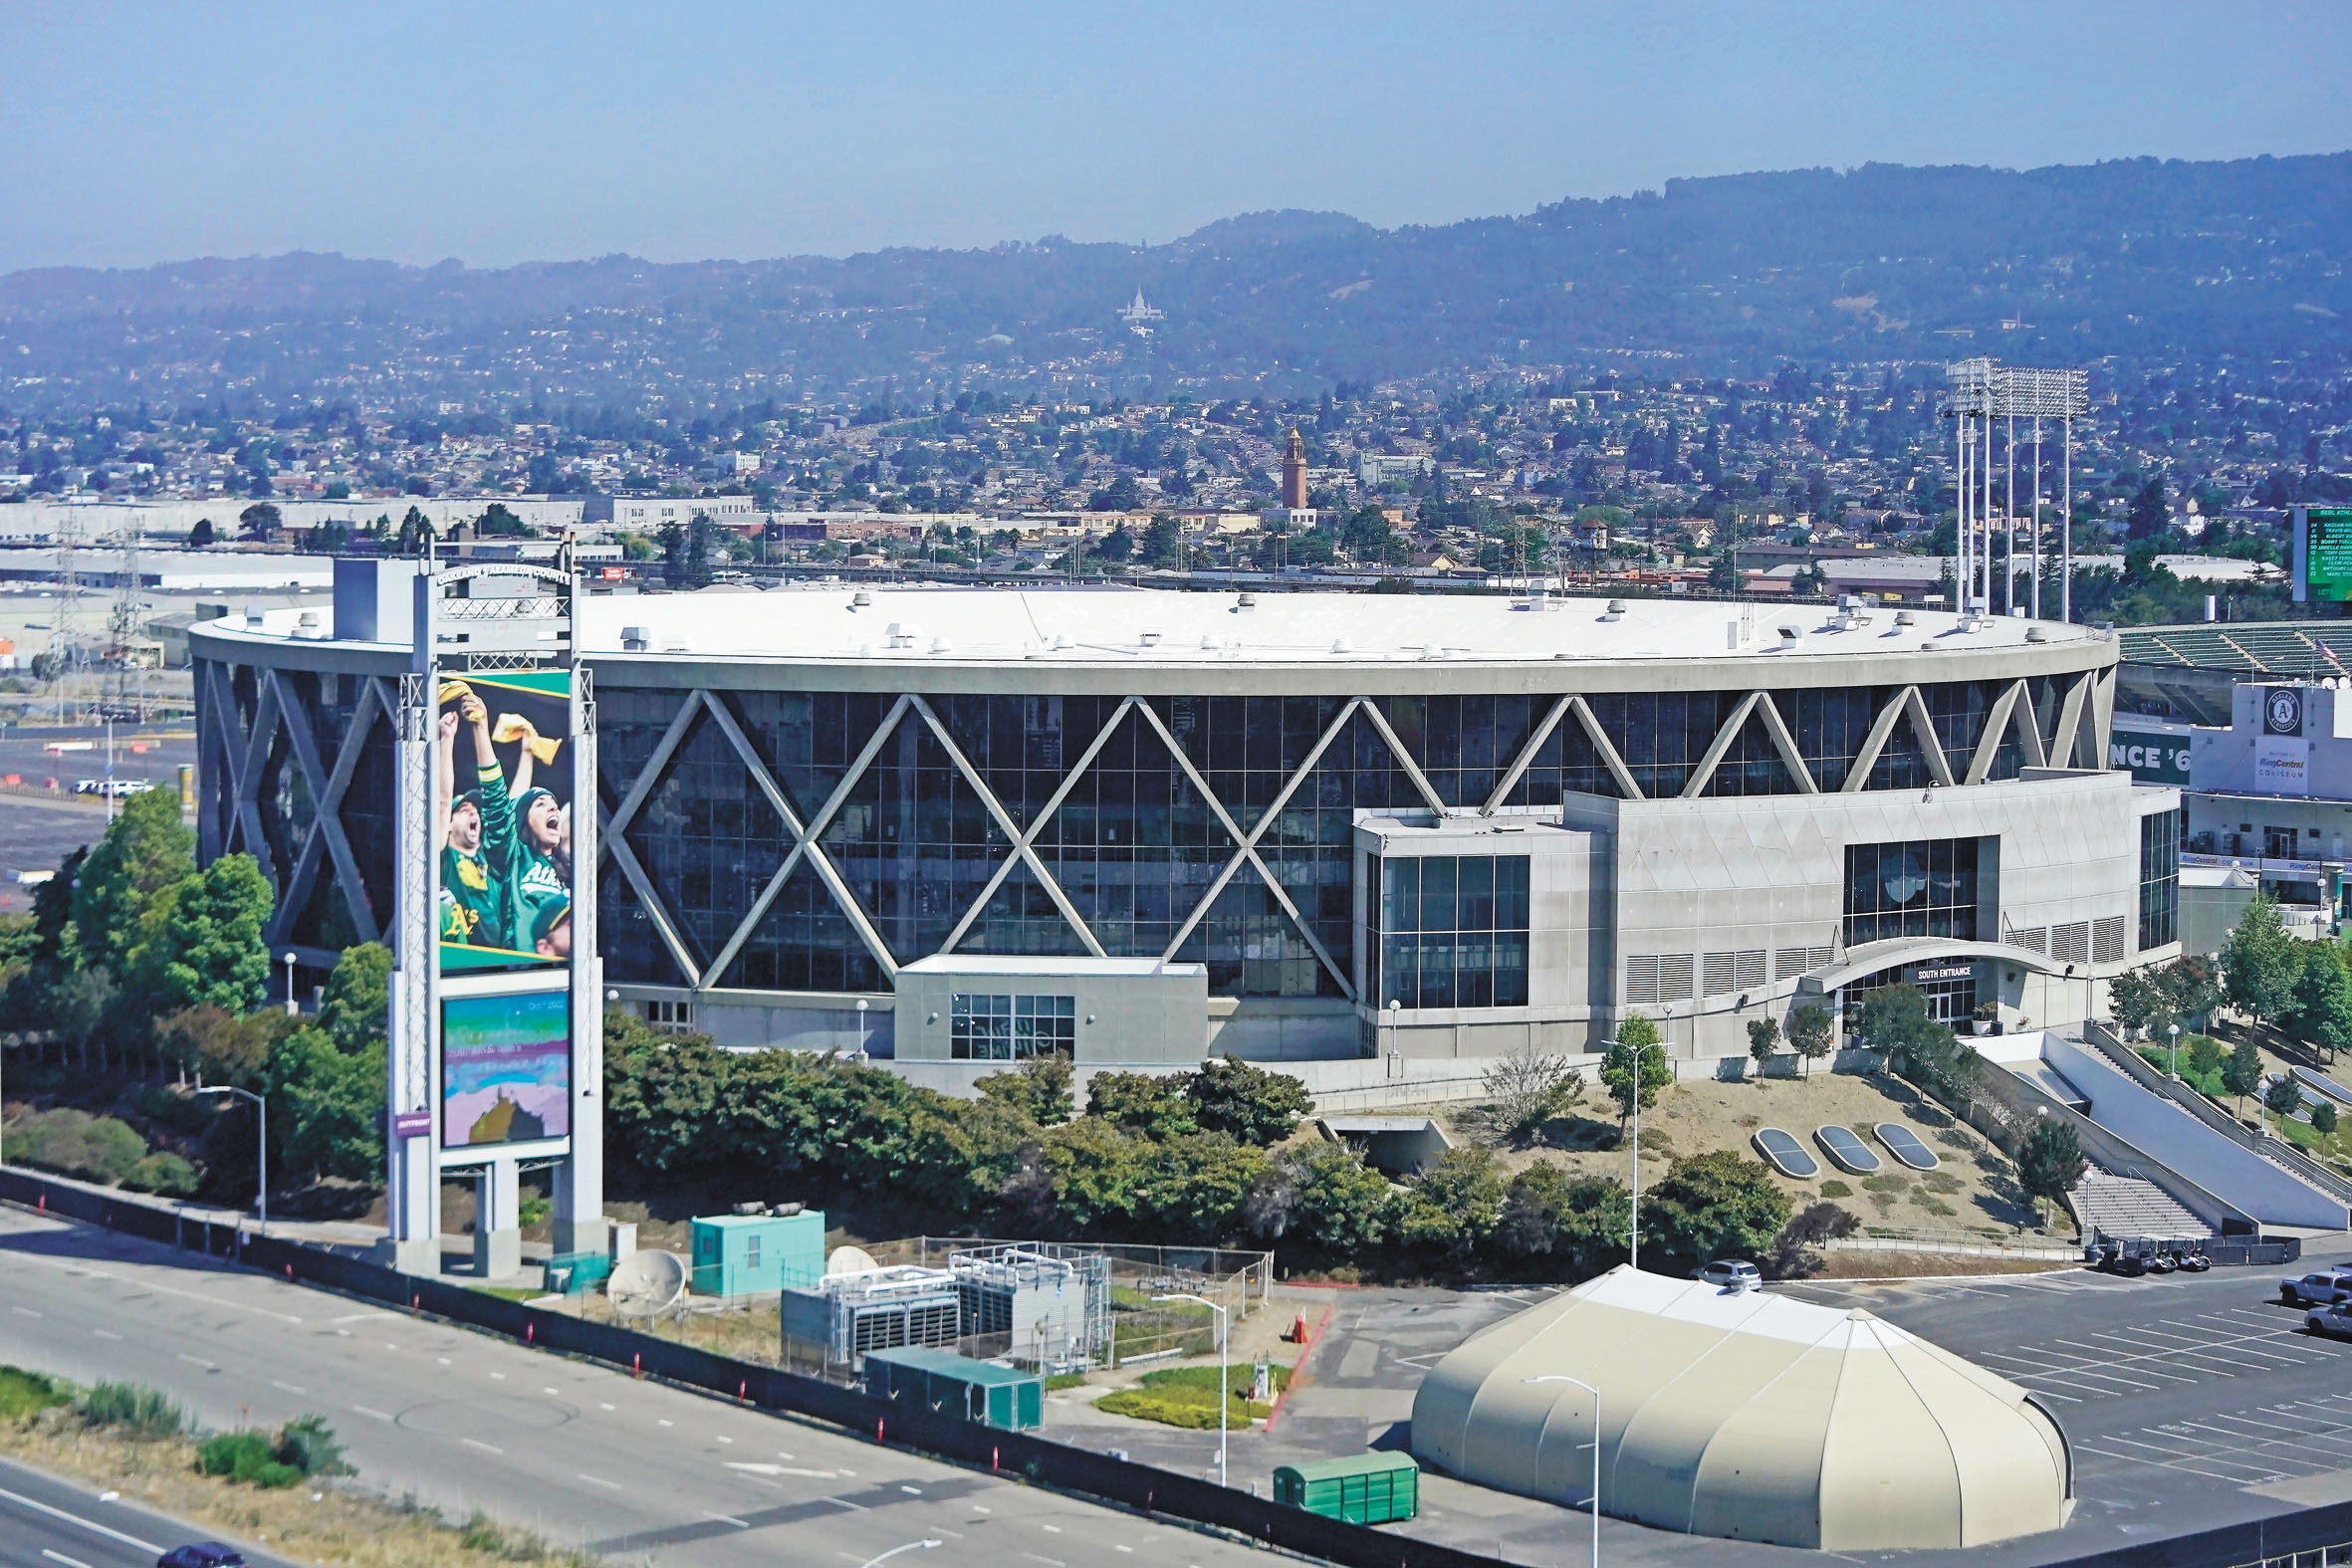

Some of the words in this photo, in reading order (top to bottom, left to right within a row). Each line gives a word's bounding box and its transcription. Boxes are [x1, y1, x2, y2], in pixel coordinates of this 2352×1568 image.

[533, 568, 572, 585] COUNTY
[444, 902, 479, 936] A's
[1918, 970, 1938, 980] SOUTH
[1940, 967, 1971, 978] ENTRANCE
